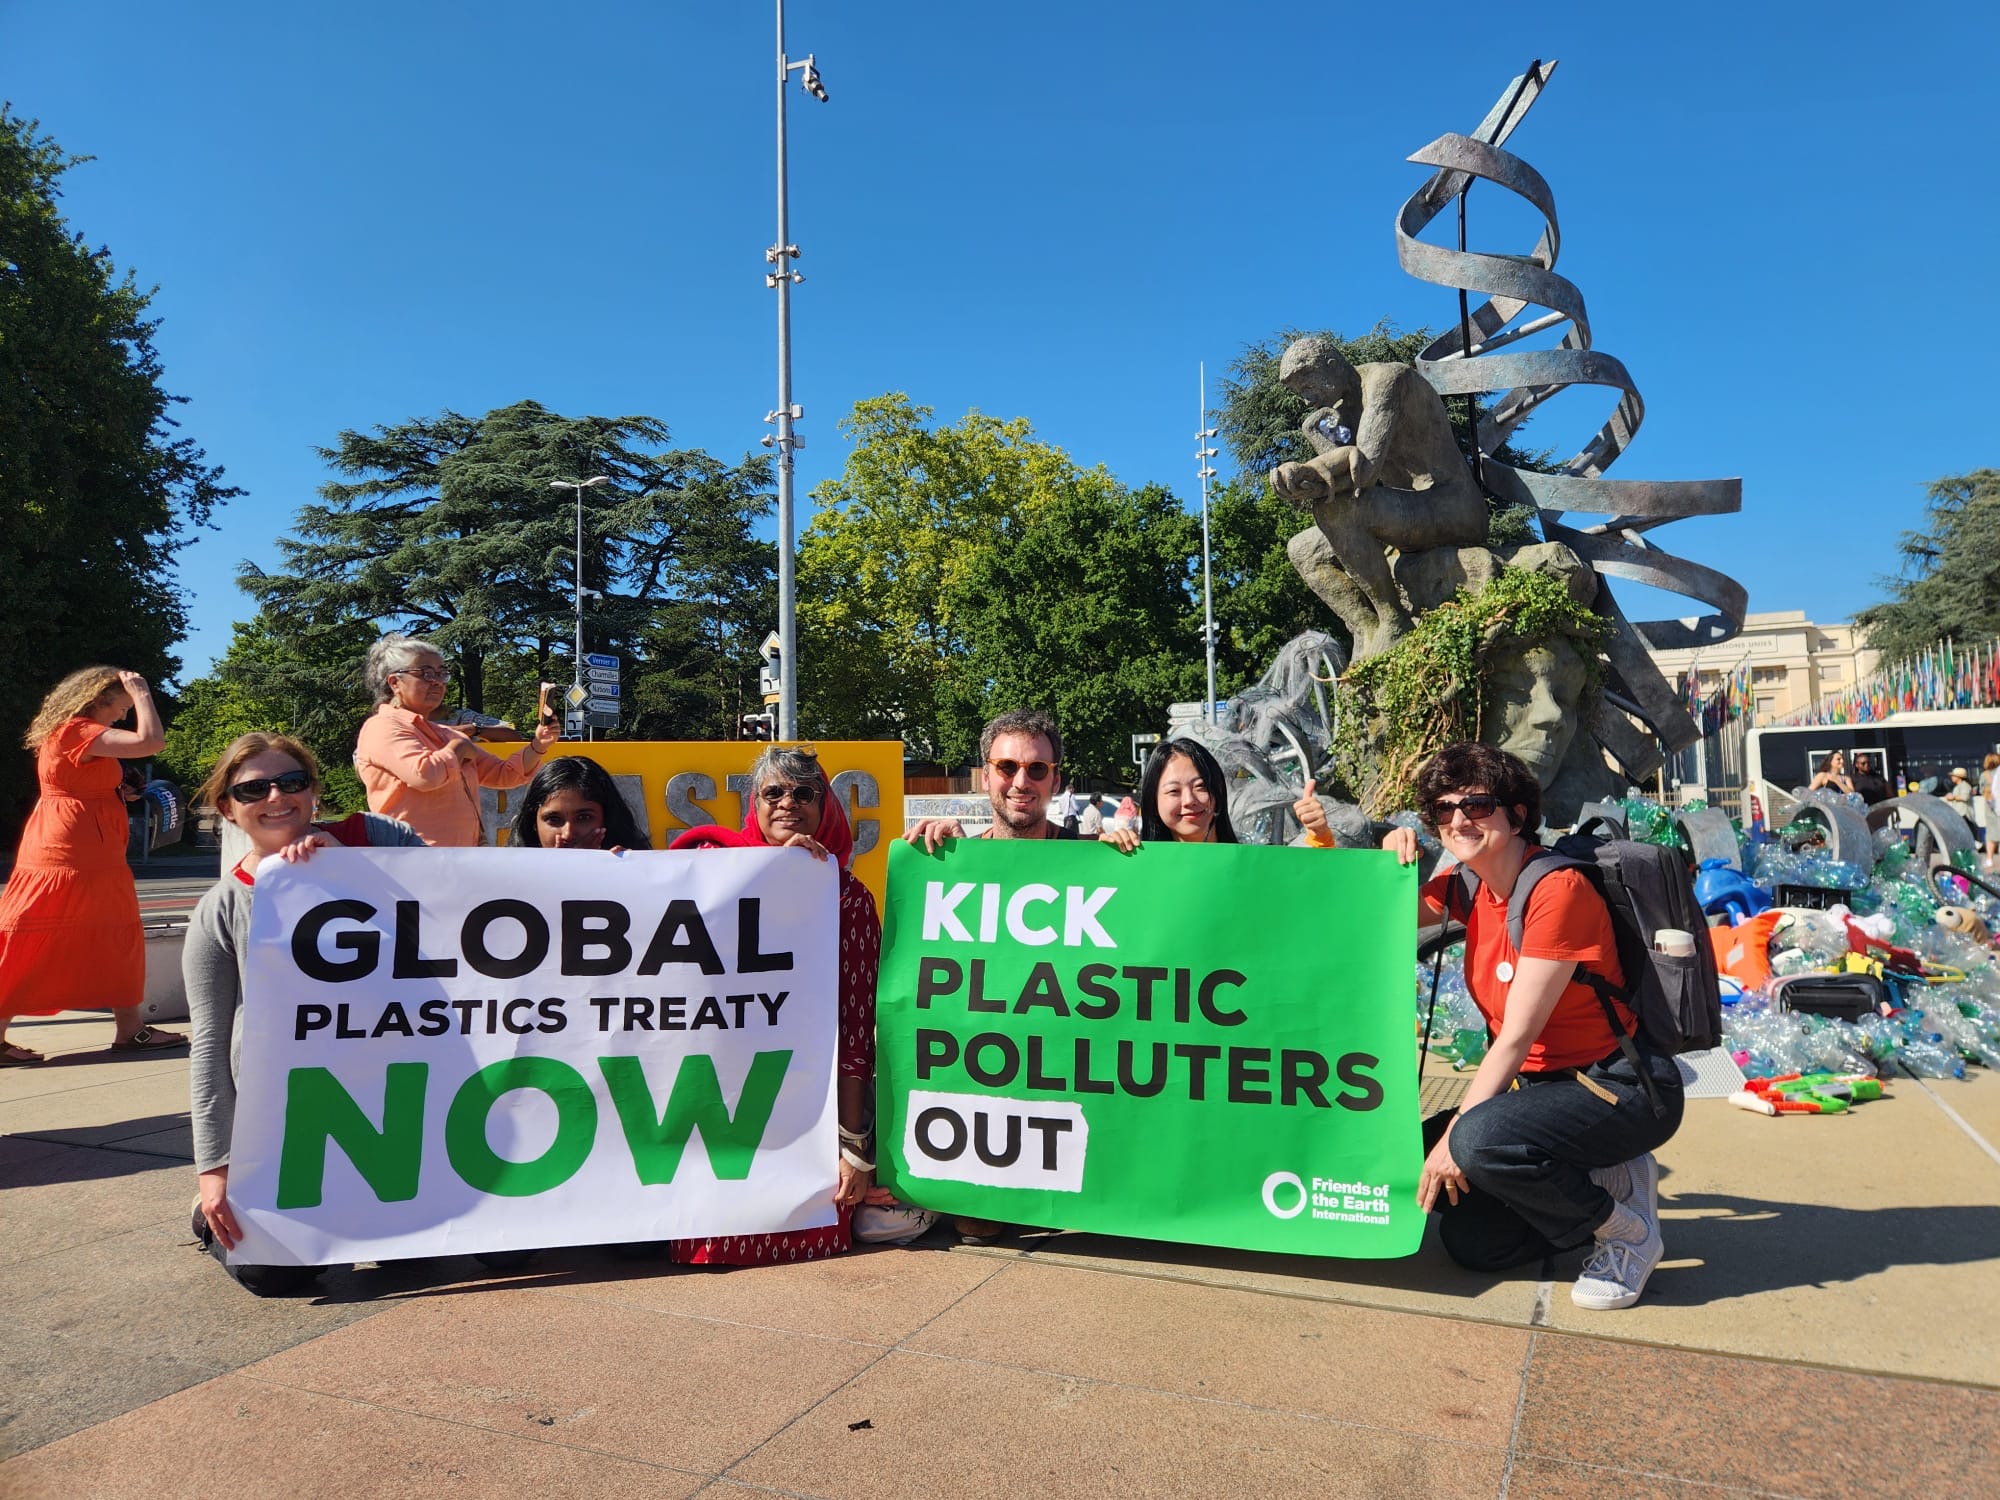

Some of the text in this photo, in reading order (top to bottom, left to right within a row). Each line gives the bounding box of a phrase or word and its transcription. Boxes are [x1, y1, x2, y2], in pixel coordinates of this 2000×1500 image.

[592, 656, 610, 666] Vernier
[148, 788, 169, 832] pollutes
[291, 898, 793, 982] GLOBAL
[921, 881, 1118, 948] KICK
[295, 991, 790, 1040] PLASTICS TREATY
[916, 956, 1249, 1026] PLASTIC
[916, 1028, 1384, 1112] POLLUTERS
[276, 1049, 794, 1209] NOW
[914, 1106, 1073, 1171] OUT
[1312, 1177, 1389, 1198] Friends of
[1312, 1193, 1389, 1213] the Earth
[1312, 1208, 1389, 1224] International
